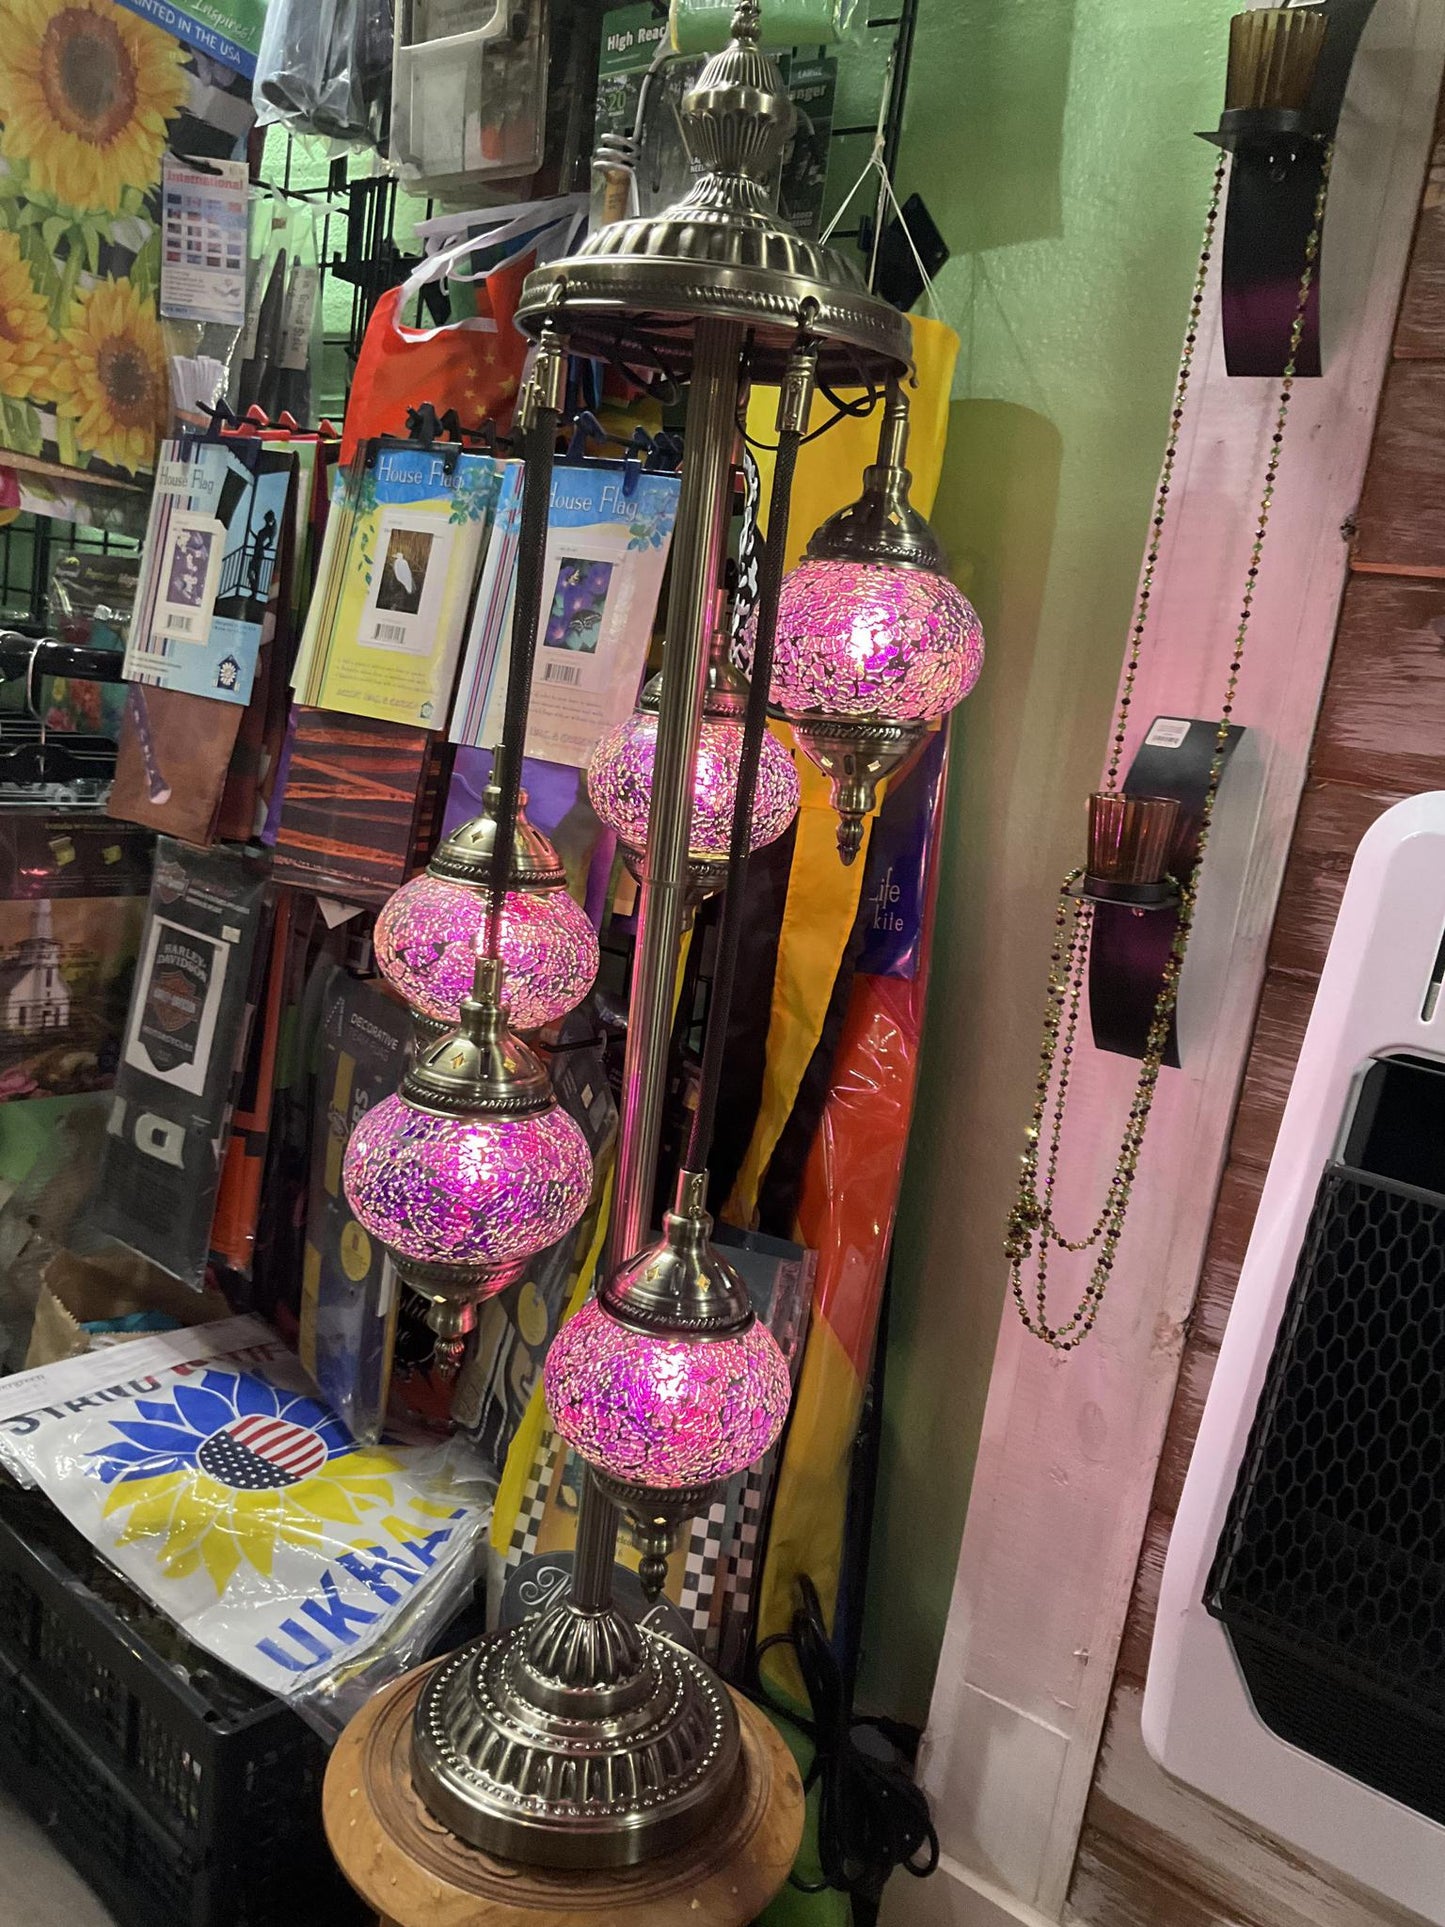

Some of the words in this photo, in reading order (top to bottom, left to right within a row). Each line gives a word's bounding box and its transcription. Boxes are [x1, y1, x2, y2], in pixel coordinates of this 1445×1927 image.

[178, 19, 192, 34] IN
[195, 26, 217, 49] THE
[220, 43, 241, 64] USA
[607, 31, 633, 51] High
[638, 26, 667, 44] Reac
[167, 170, 243, 191] International
[159, 466, 188, 488] House
[191, 469, 215, 496] Flag
[376, 456, 423, 485] House
[599, 485, 640, 522] Flag
[351, 1013, 399, 1051] DECORATIVE
